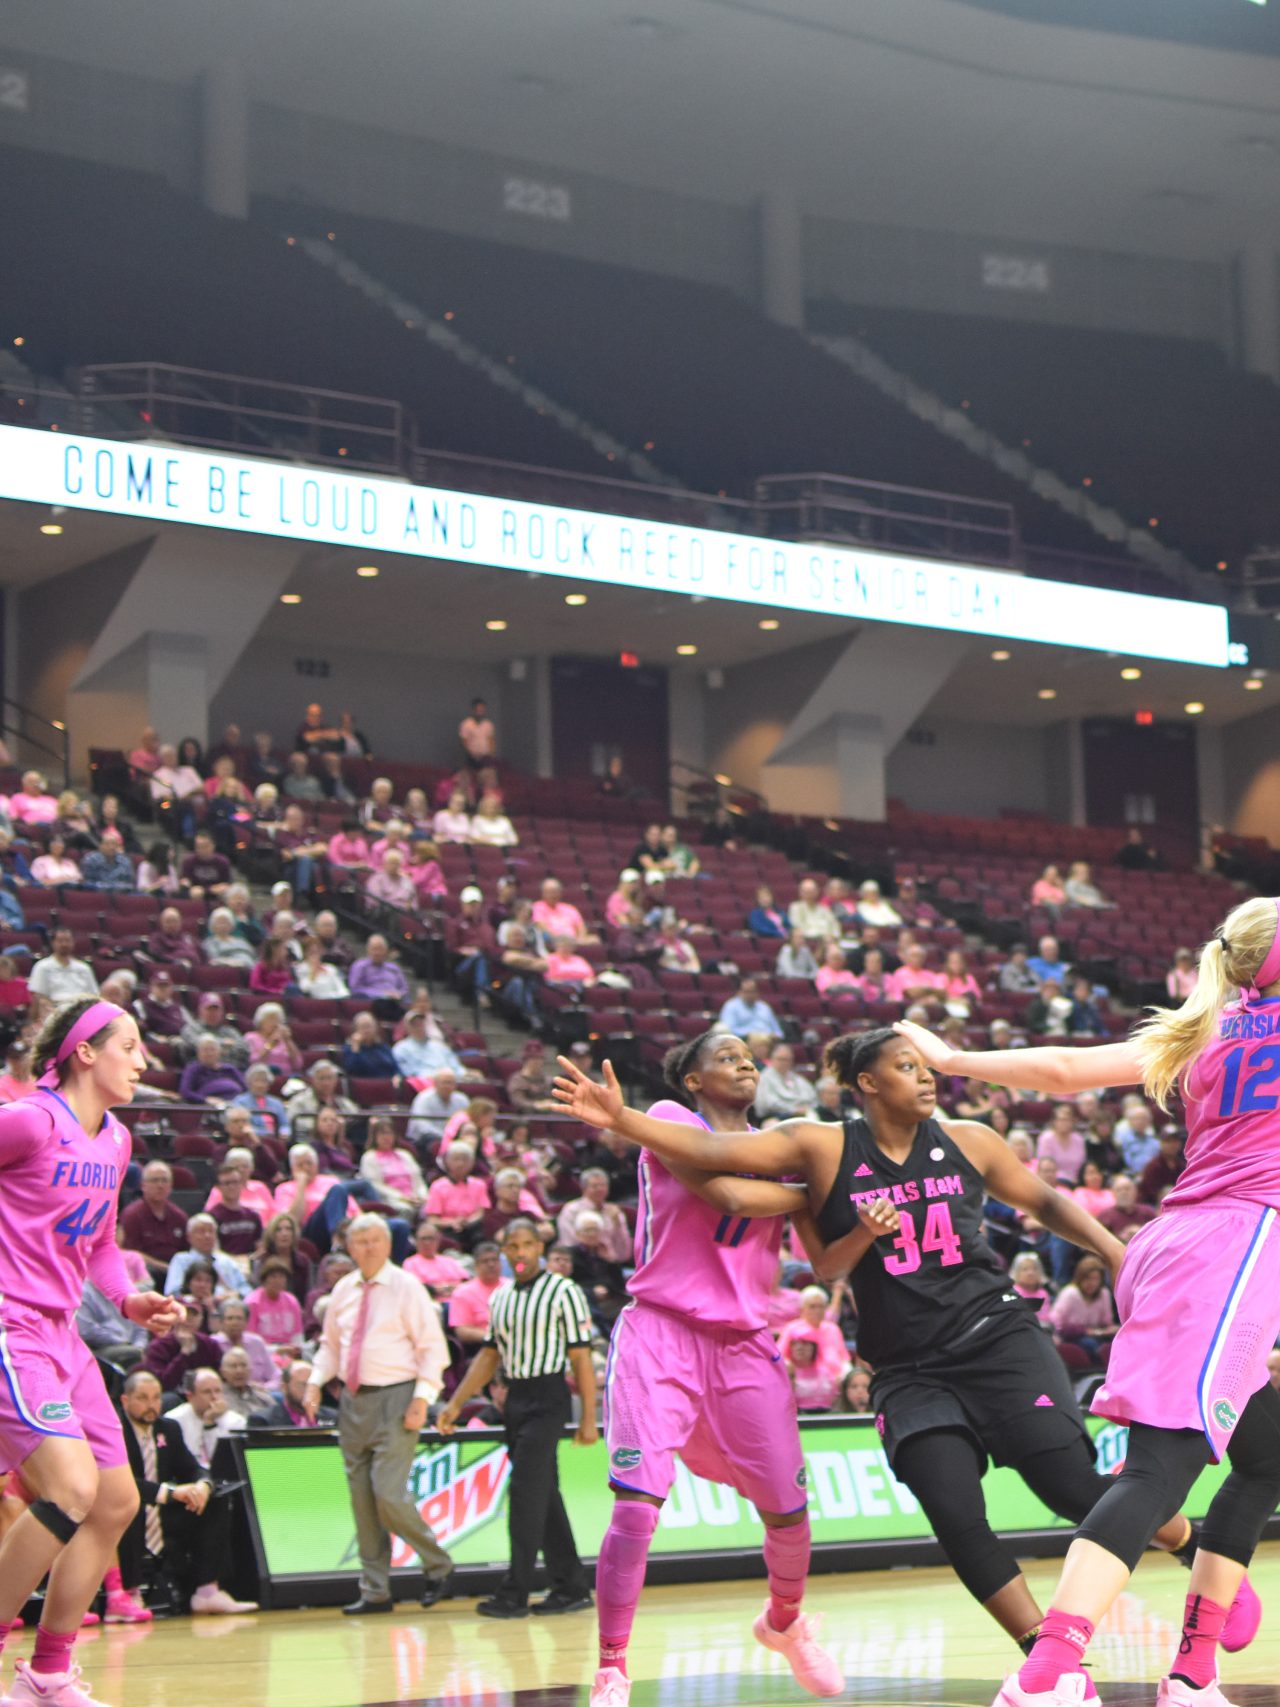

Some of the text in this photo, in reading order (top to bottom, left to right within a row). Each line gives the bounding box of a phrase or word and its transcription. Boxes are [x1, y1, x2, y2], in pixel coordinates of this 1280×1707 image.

[63, 445, 180, 508] COME
[208, 465, 252, 518] BE
[279, 475, 378, 536] LOUD
[403, 495, 476, 550] AND
[502, 509, 596, 567] ROCK
[619, 526, 704, 583] REED
[728, 543, 788, 593] FOR
[808, 555, 928, 611] SENIOR
[849, 1174, 964, 1208] TEXAS A&M
[54, 1198, 110, 1246] 44
[883, 1201, 964, 1276] 34
